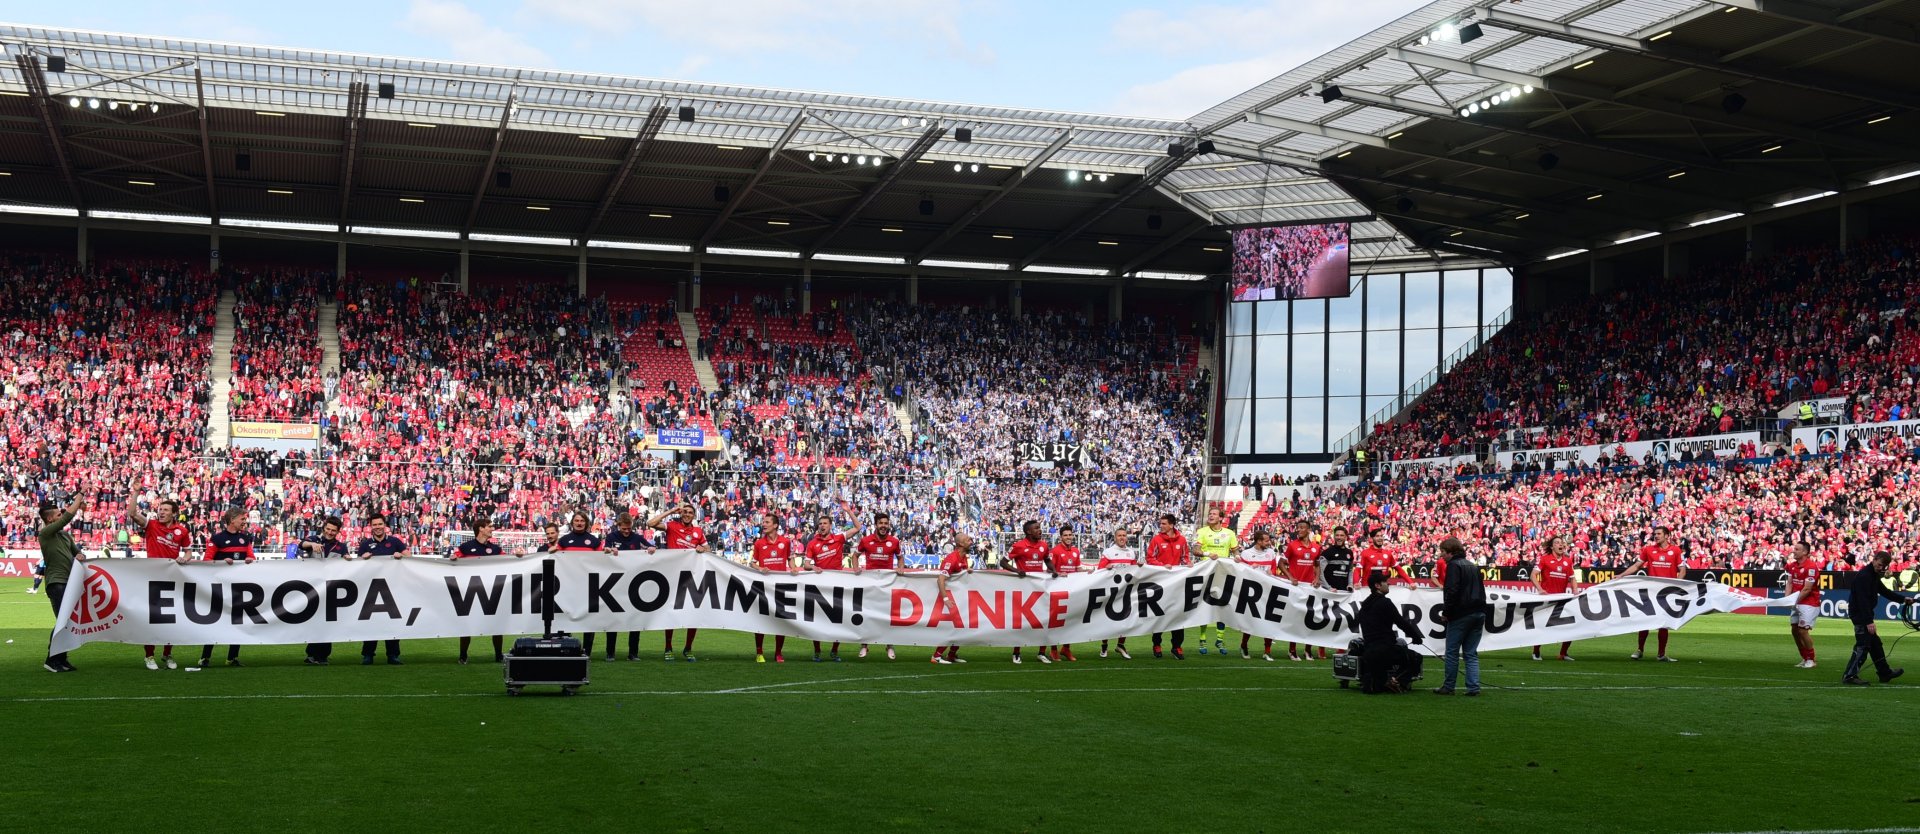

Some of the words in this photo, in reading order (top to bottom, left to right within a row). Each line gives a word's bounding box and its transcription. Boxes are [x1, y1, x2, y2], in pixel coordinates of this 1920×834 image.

[236, 425, 277, 435] Ökostrom
[1530, 450, 1579, 465] KÖMERLING
[148, 577, 421, 627] EUROPA,
[444, 573, 564, 616] WIR
[588, 569, 864, 626] KOMMEN!
[890, 588, 1069, 629] DANKE
[1082, 573, 1166, 624] FÜR
[1184, 573, 1290, 623] EURE
[1304, 583, 1707, 639] UNRSÜTZUNG!
[112, 613, 124, 625] 05
